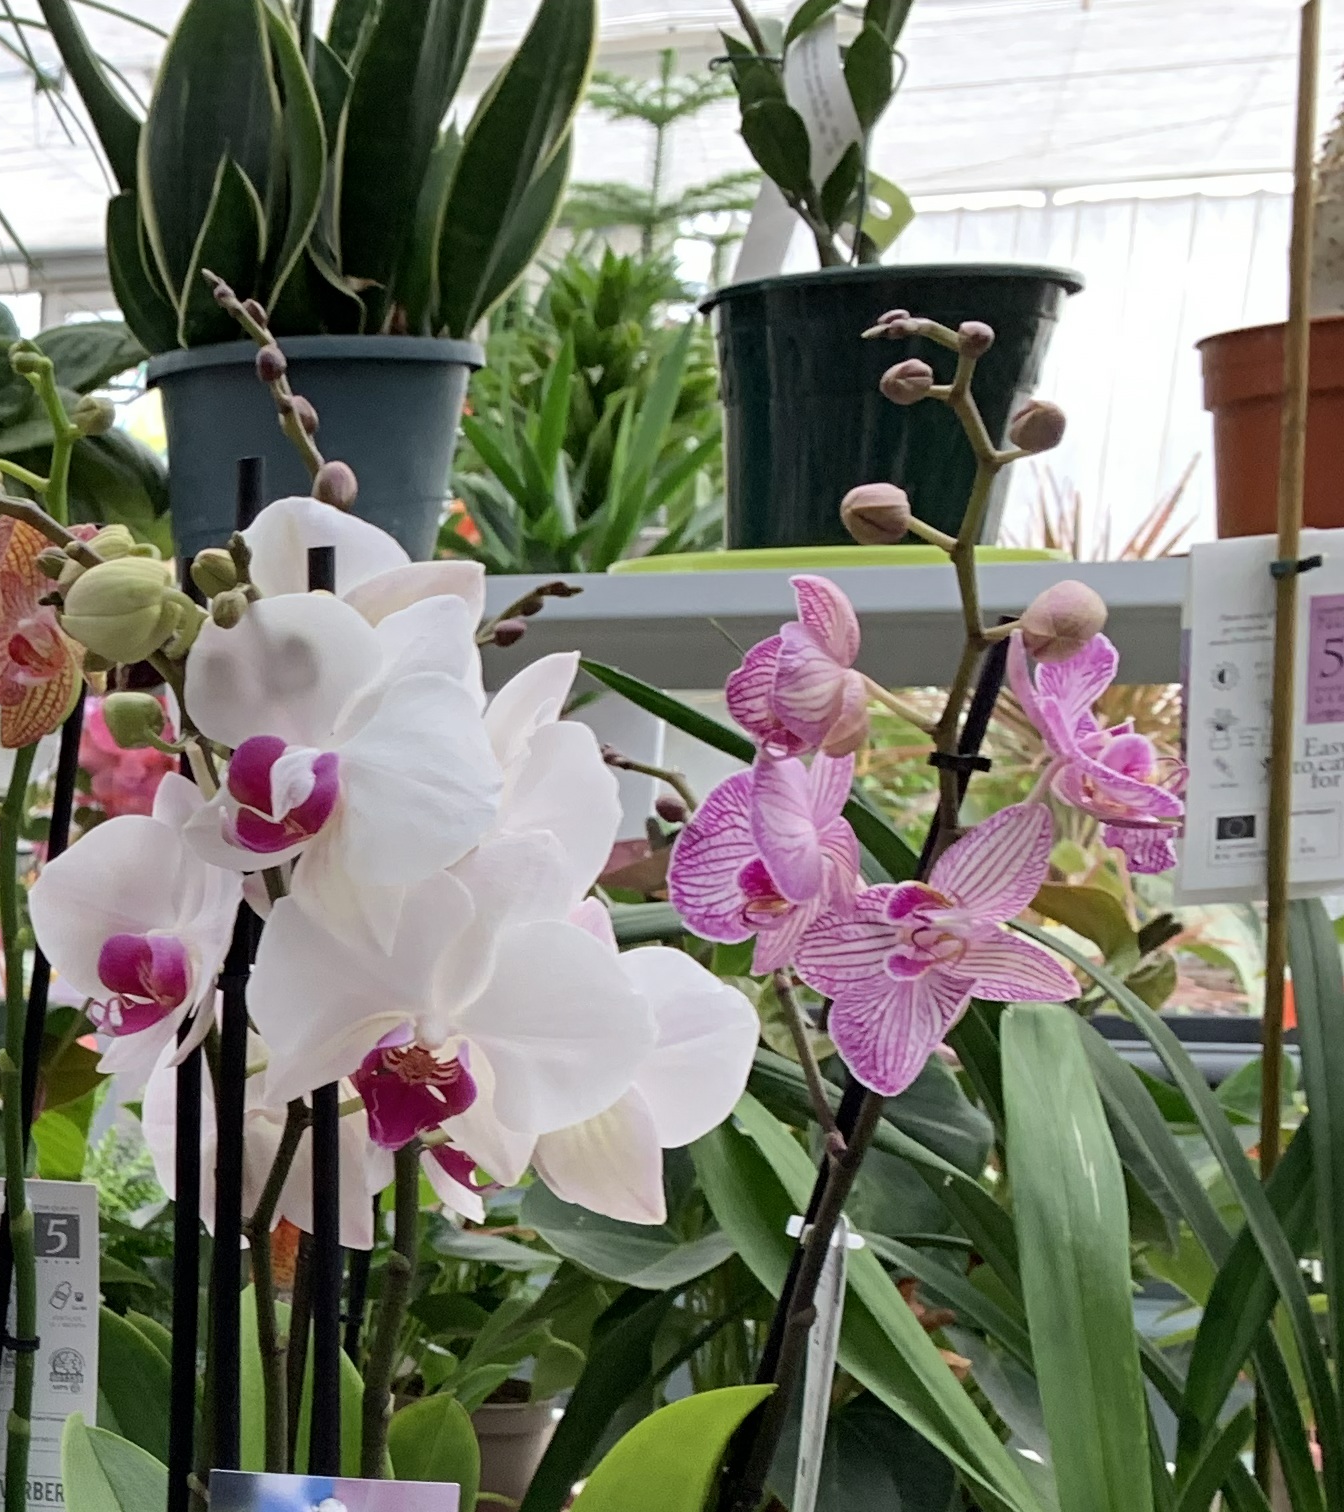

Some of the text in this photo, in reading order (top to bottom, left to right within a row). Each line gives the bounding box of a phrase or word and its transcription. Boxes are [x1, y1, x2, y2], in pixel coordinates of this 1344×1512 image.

[1320, 637, 1344, 679] 5
[1304, 736, 1344, 758] Eas
[45, 1218, 68, 1255] 5
